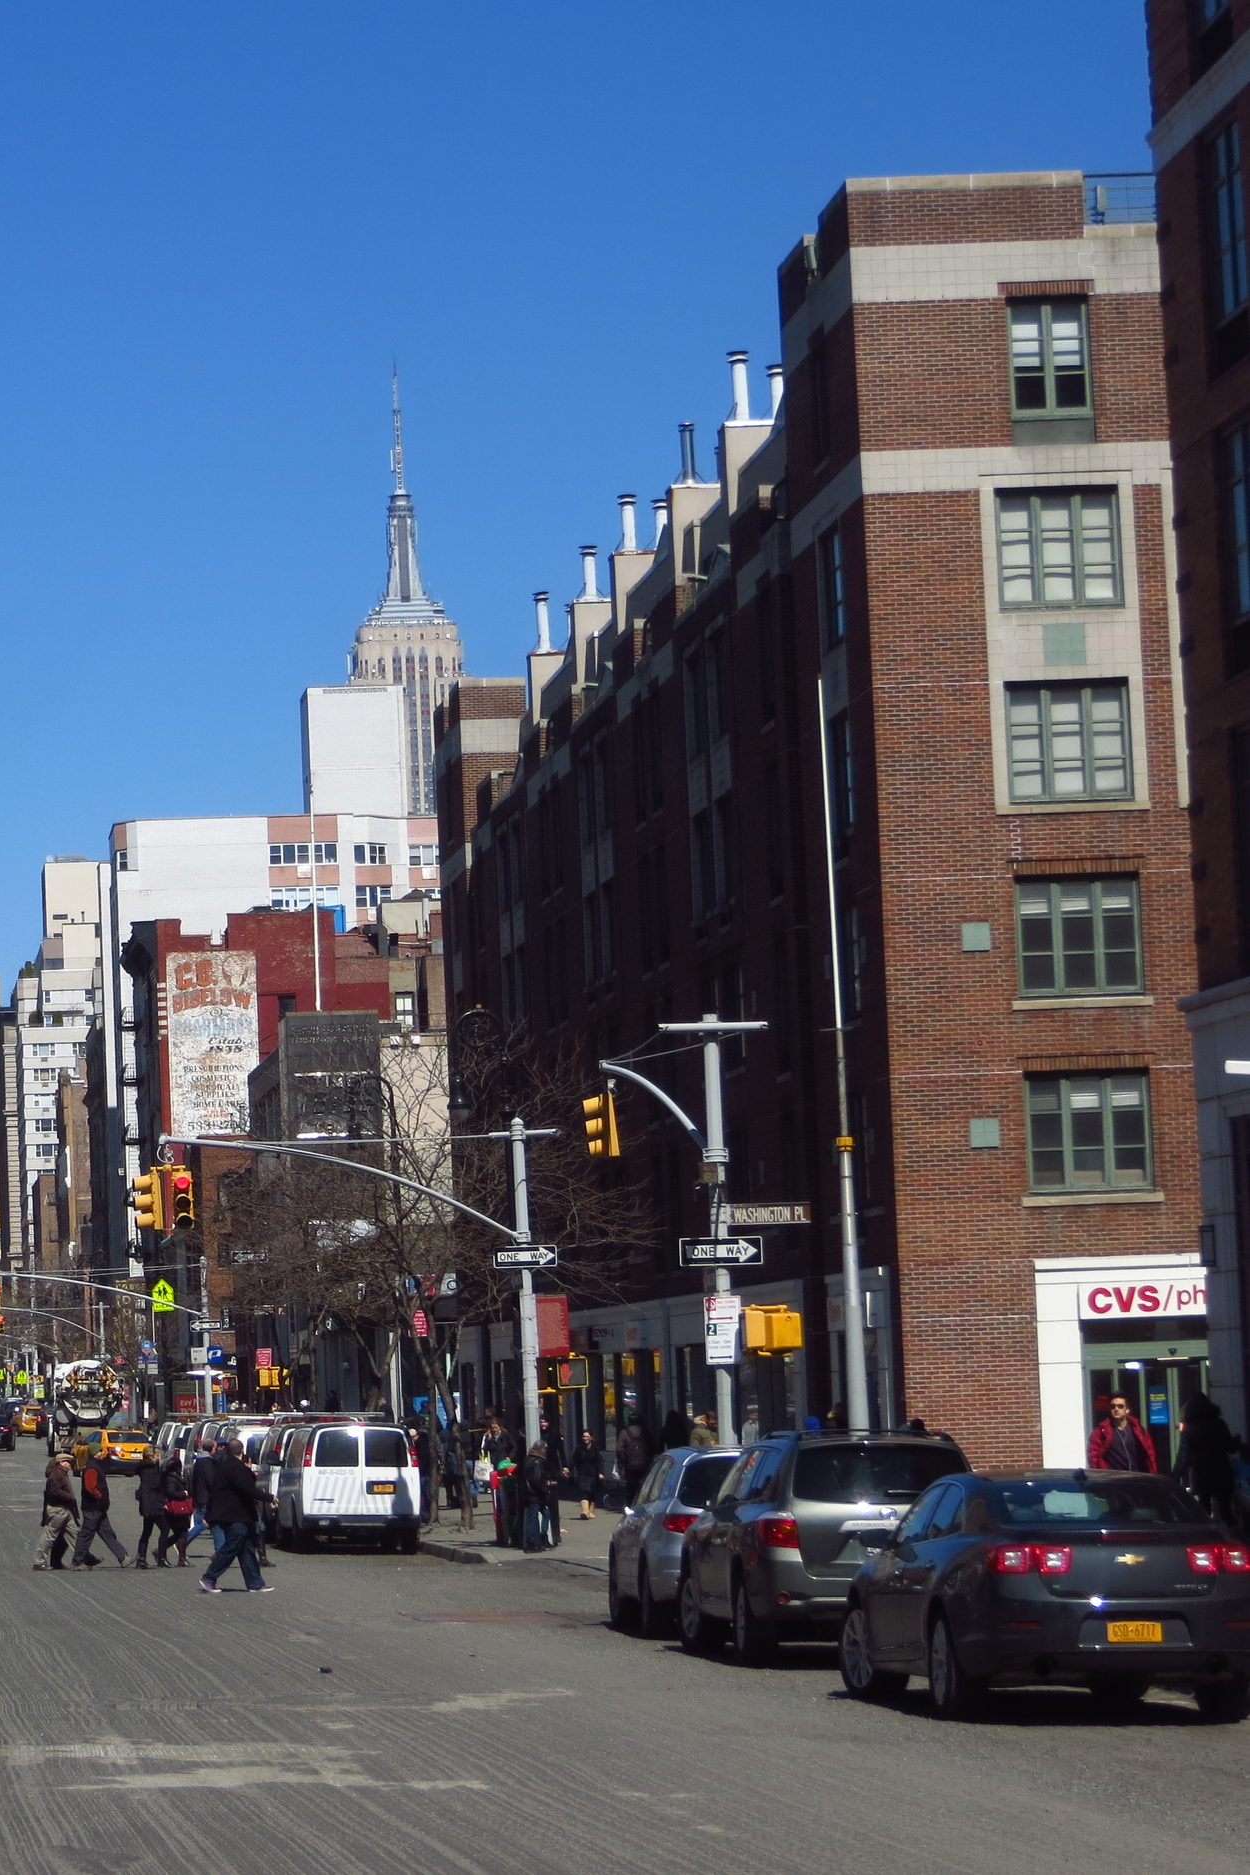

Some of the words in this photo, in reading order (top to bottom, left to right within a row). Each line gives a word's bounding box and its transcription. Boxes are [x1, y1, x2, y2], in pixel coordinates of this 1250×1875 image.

[172, 986, 251, 1014] BIGELOW
[191, 1073, 238, 1082] COSMETICS
[195, 1090, 236, 1098] SUPPLIES
[193, 1100, 217, 1109] HOME
[733, 1206, 791, 1223] WASHINGTON
[794, 1206, 806, 1221] PL
[499, 1252, 520, 1262] ONE
[529, 1251, 550, 1261] WAY
[692, 1246, 715, 1258] ONE
[725, 1245, 750, 1257] WAY
[708, 1324, 715, 1335] 2
